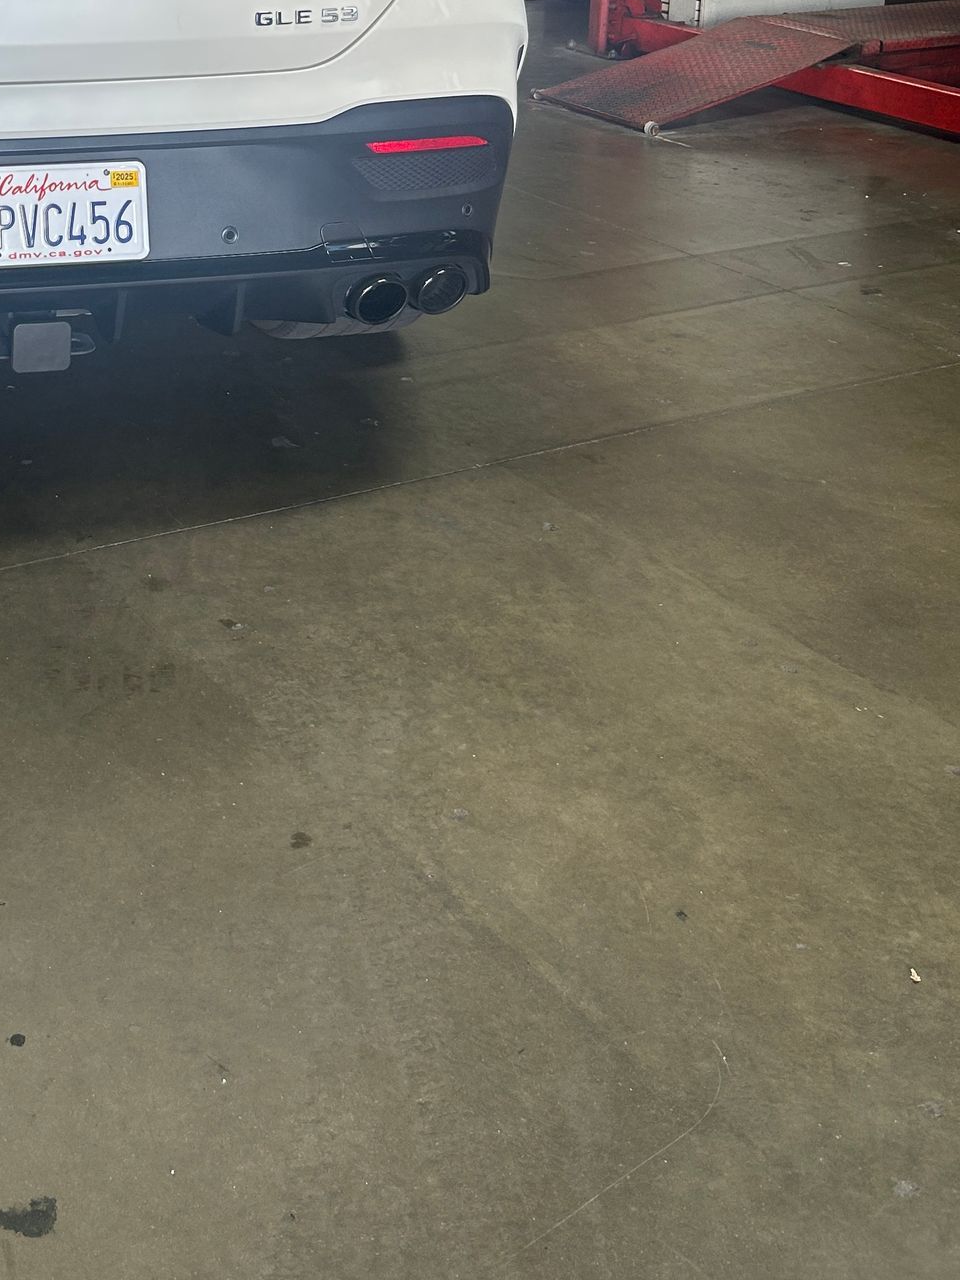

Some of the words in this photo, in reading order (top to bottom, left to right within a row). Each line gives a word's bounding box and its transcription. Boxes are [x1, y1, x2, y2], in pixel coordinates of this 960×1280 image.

[255, 10, 312, 26] GLE
[321, 6, 358, 23] 53
[116, 172, 134, 181] 2025
[8, 248, 103, 260] dmv.ca.gov
